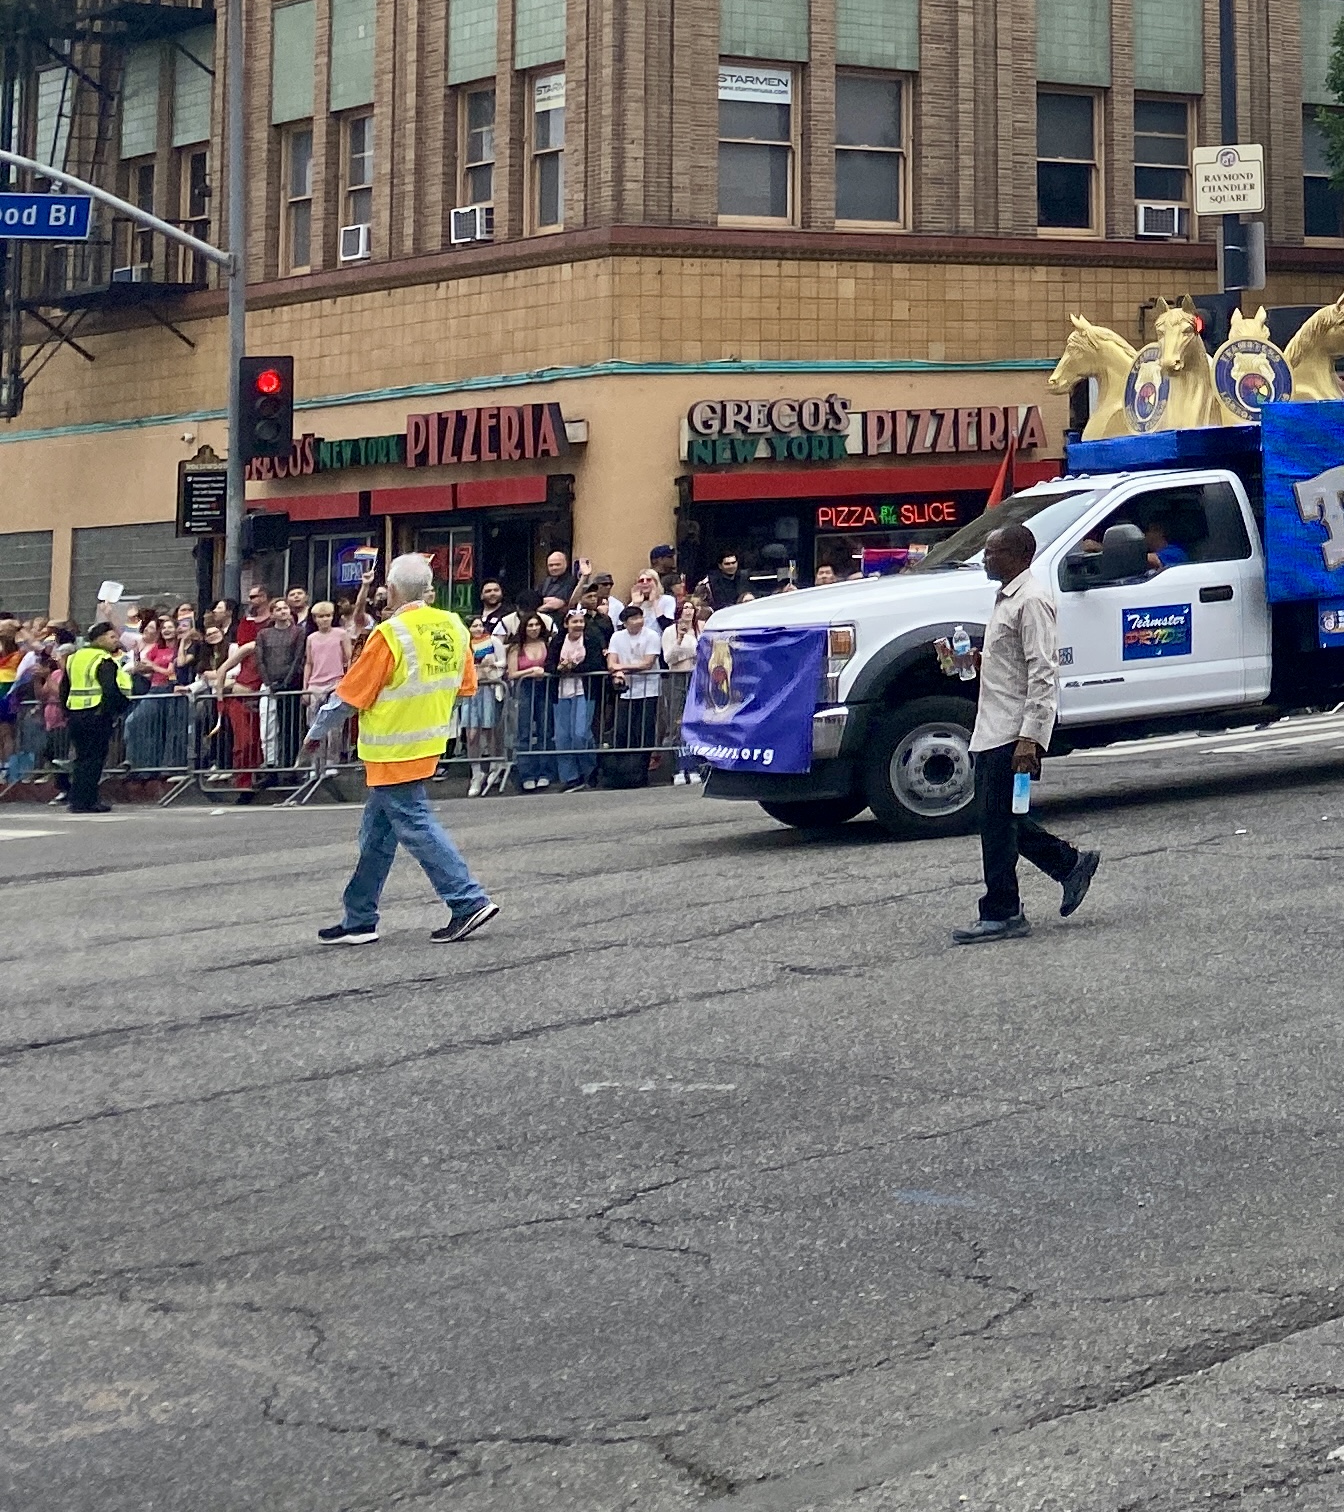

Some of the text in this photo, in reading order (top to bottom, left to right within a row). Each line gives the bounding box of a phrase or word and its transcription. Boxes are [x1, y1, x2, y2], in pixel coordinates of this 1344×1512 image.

[718, 73, 789, 88] STARMEN
[1201, 183, 1256, 194] CHANDLER
[1204, 172, 1254, 183] RAYMOND
[1209, 193, 1249, 204] SQUARE
[0, 204, 76, 226] od Bl
[687, 393, 851, 436] GRECO'S
[406, 403, 560, 468] PIZZERIA
[866, 405, 1049, 456] PIZZERIA
[319, 439, 351, 470] NEW
[358, 435, 400, 466] YORK
[687, 434, 849, 465] NEW YORK
[818, 502, 956, 528] PIZZA BY THE SLICE
[1126, 614, 1185, 629] Teamster
